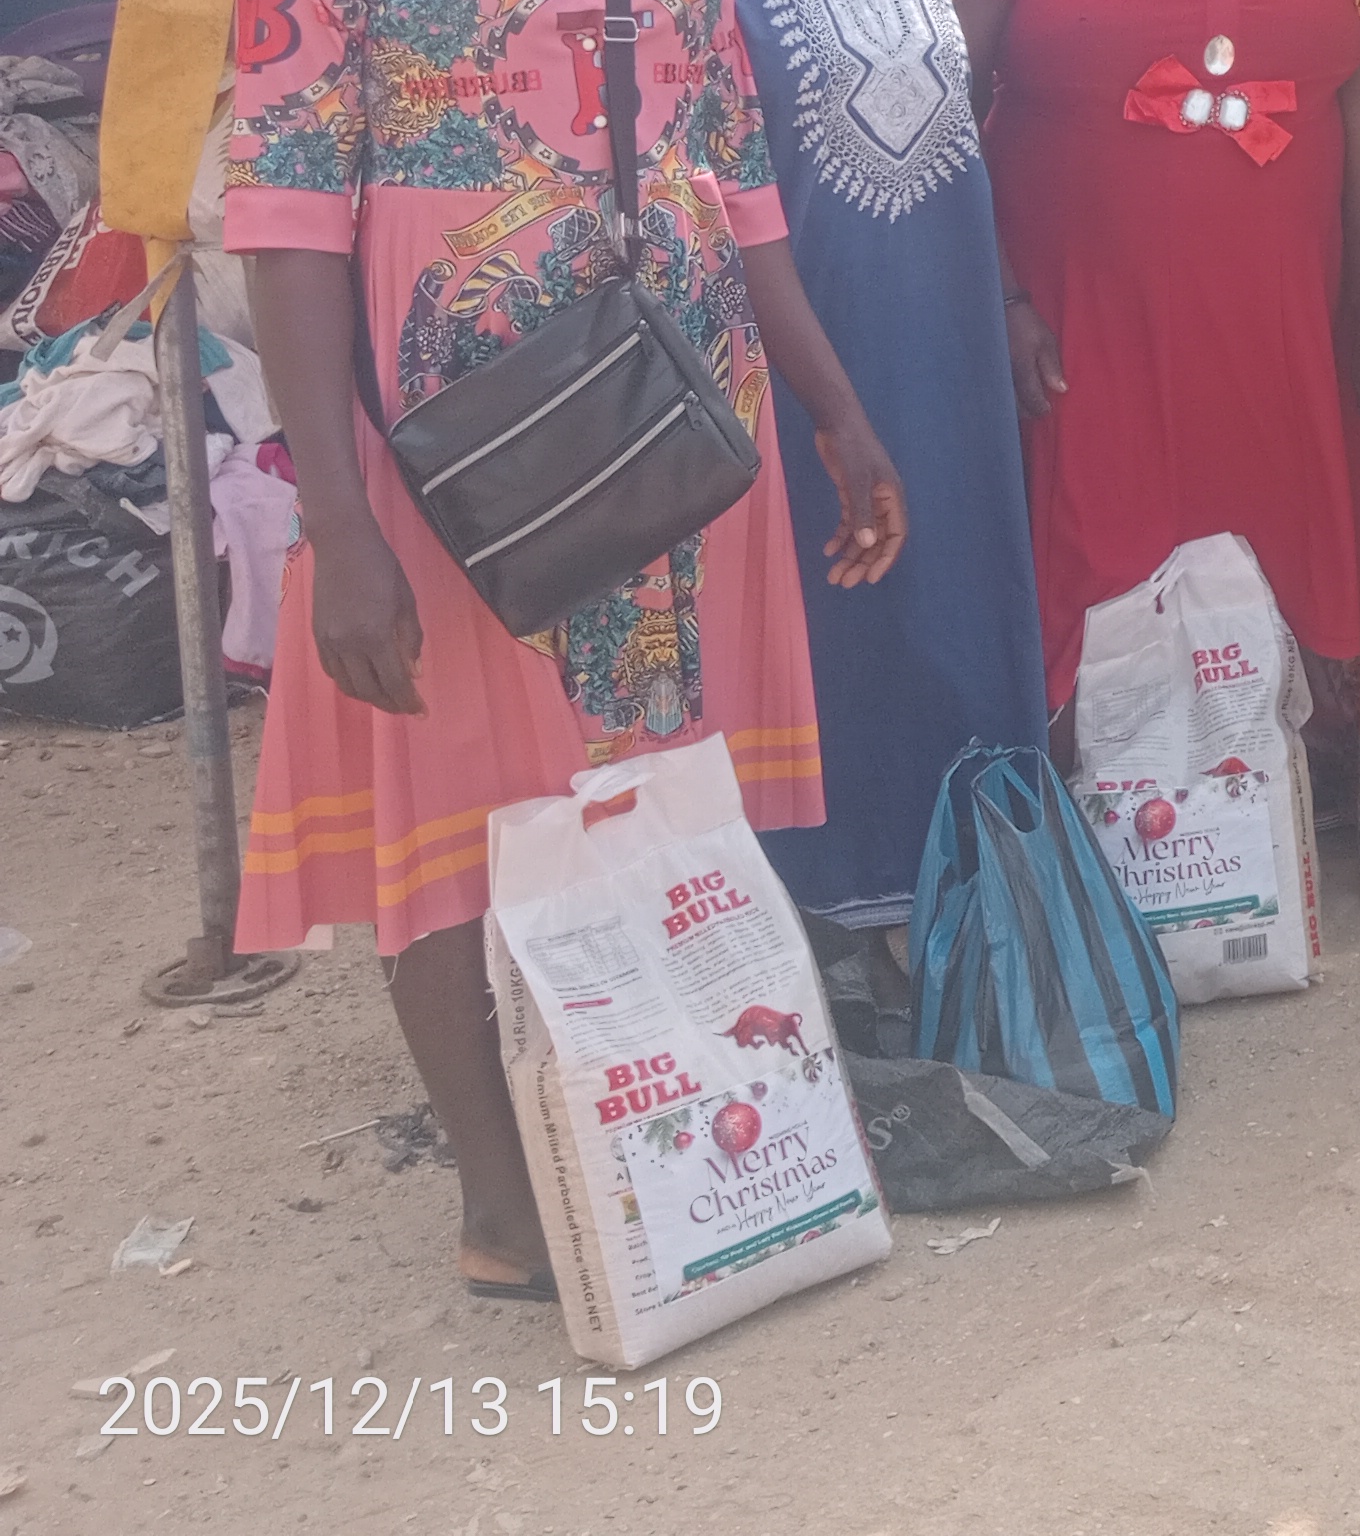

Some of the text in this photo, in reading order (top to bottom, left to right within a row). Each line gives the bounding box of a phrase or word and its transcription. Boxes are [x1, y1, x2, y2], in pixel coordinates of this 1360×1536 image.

[1192, 642, 1242, 670] BIG
[1122, 833, 1221, 864] Merry
[665, 869, 725, 910] BIG
[661, 888, 752, 940] BULL
[510, 968, 525, 1034] Rice 10KG
[604, 1052, 677, 1092] BIG
[595, 1072, 702, 1126] BULL
[545, 1122, 564, 1164] Milled
[703, 1126, 810, 1192] Merry
[555, 1166, 578, 1231] Parboiled
[689, 1148, 838, 1224] Christmas
[570, 1232, 584, 1265] Rice
[577, 1267, 596, 1305] 10KG
[586, 1305, 603, 1334] NET
